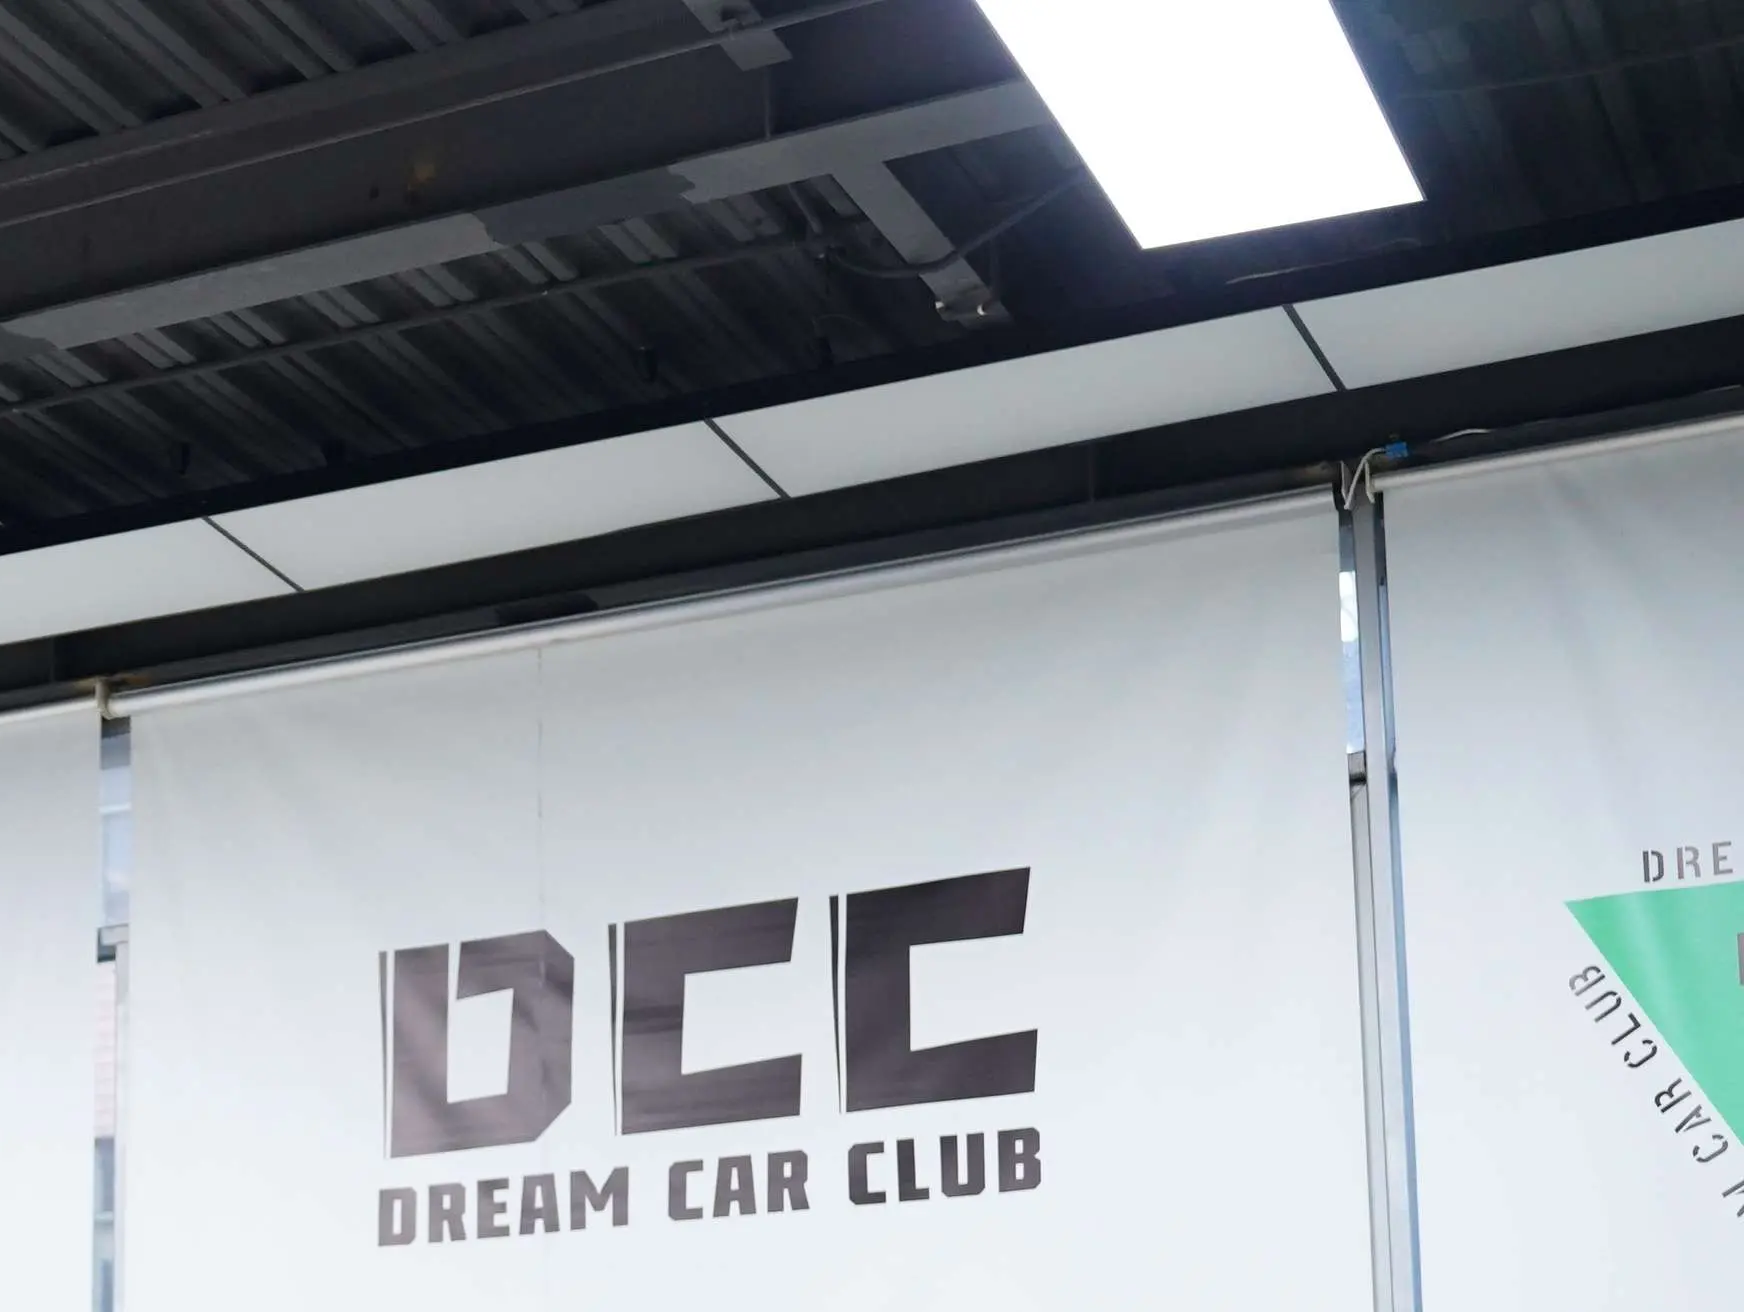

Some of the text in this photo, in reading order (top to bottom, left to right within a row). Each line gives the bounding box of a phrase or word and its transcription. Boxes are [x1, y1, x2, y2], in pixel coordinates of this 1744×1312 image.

[1643, 842, 1733, 883] DRE
[378, 866, 1038, 1158] DCC
[1569, 966, 1728, 1163] CAR CLUB
[378, 1127, 1041, 1246] DREAM CAR CLUB
